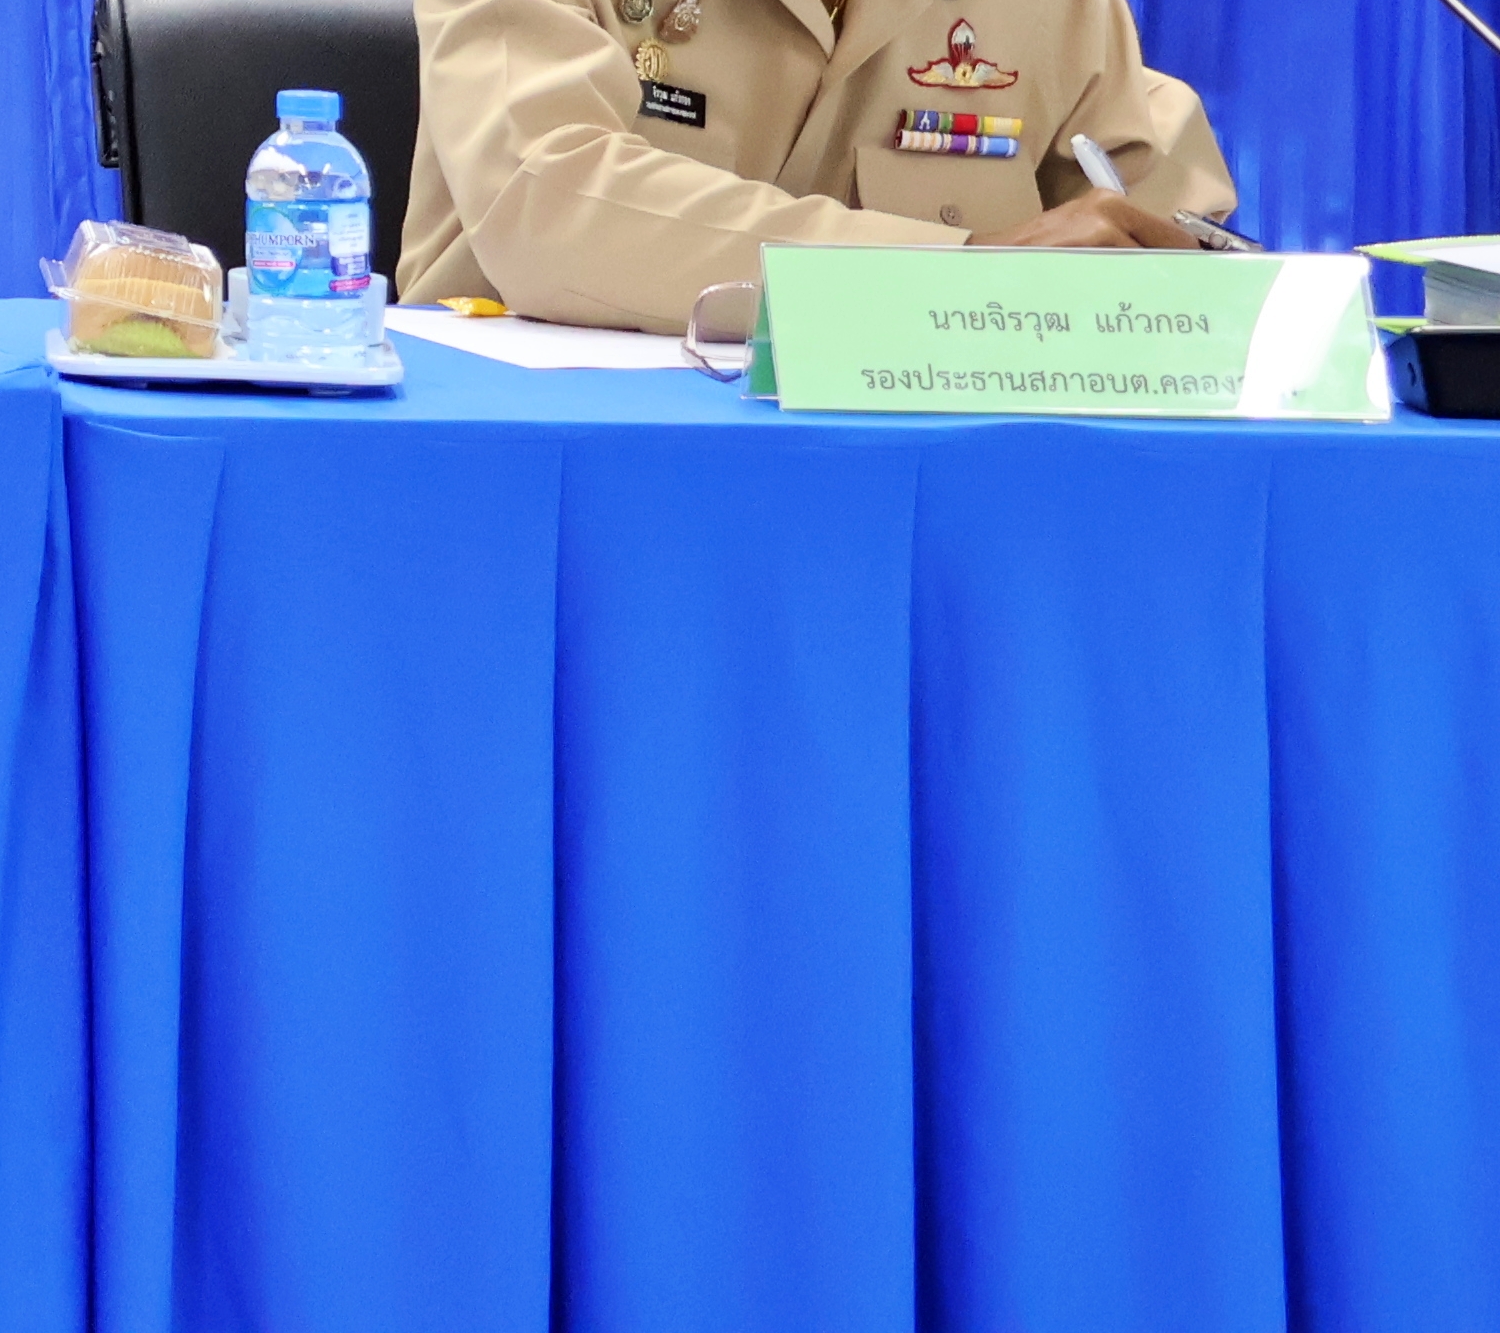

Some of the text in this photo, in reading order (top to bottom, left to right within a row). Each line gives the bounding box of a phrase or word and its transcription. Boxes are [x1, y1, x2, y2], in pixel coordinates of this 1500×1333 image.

[928, 301, 1210, 342] นายจิรวุฒ แก้วกอง
